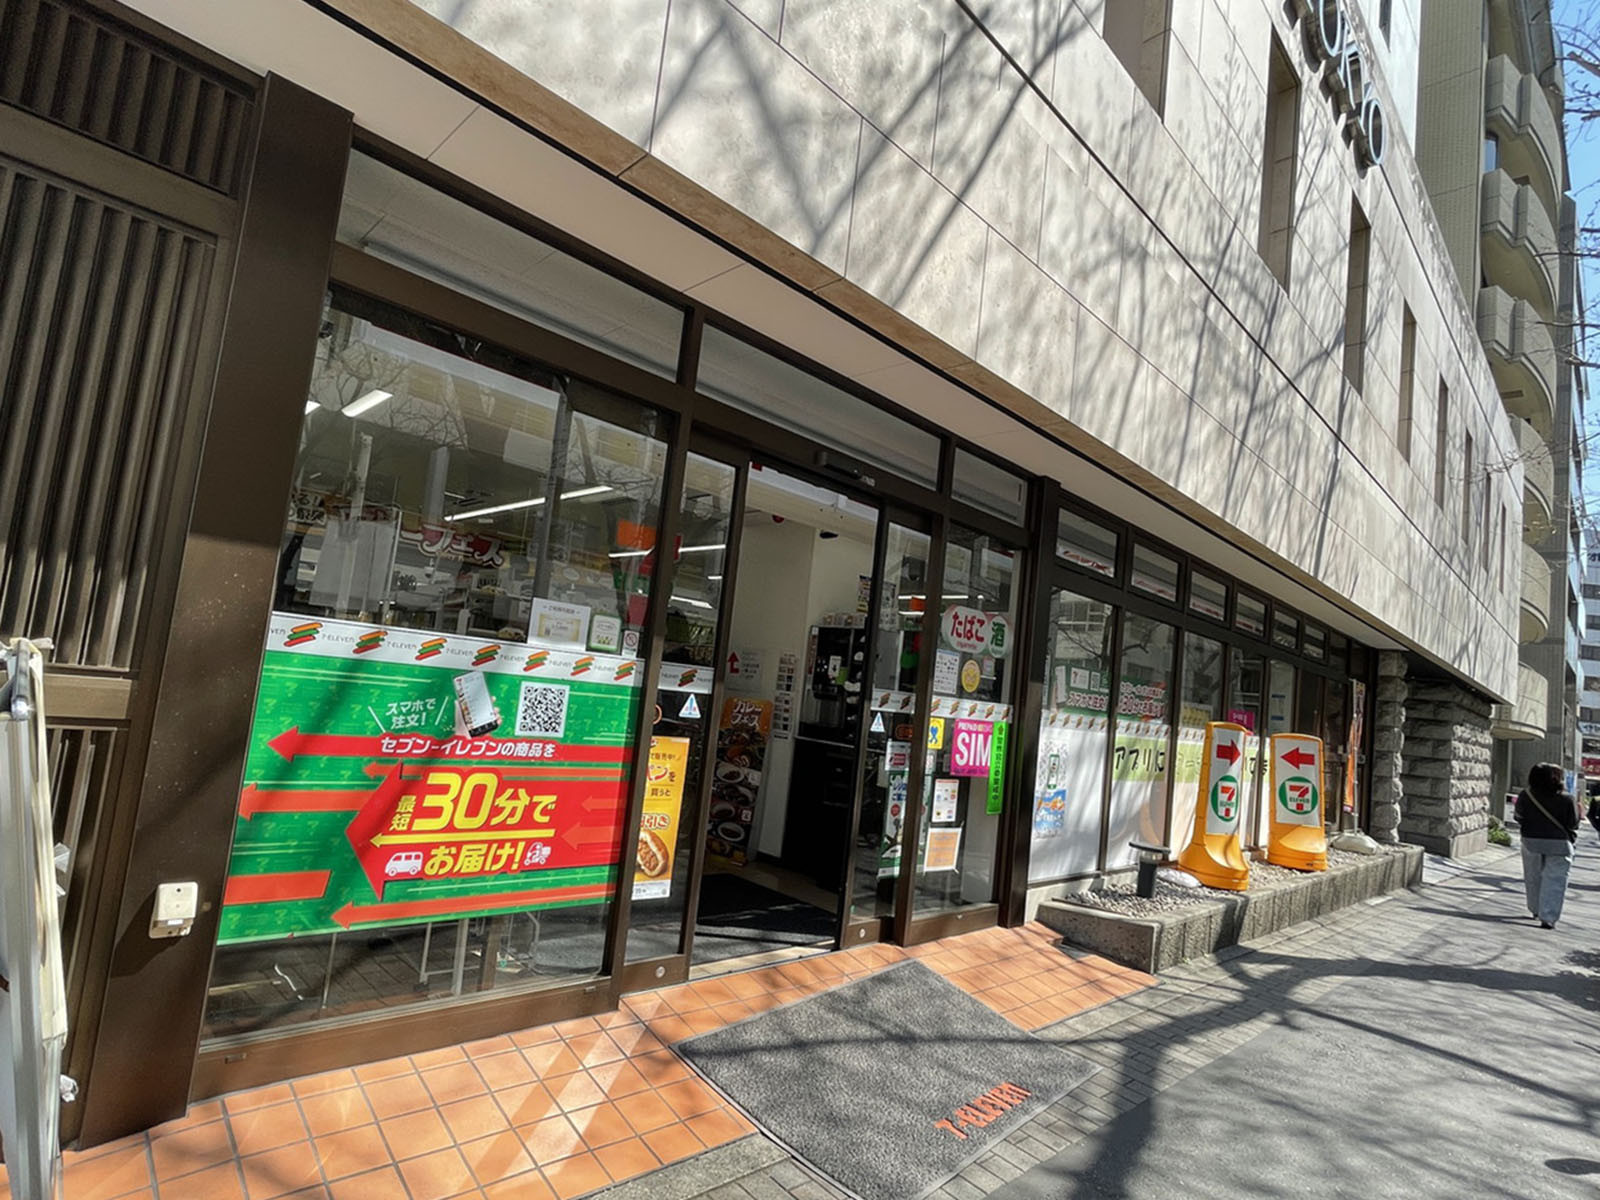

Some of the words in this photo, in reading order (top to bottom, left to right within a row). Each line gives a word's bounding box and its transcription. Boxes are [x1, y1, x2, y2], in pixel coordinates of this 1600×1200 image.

[951, 611, 985, 642] たばこ
[990, 621, 1006, 647] 酒
[386, 698, 436, 716] スマホで
[391, 713, 427, 730] 注文!
[955, 731, 993, 767] SIM
[389, 795, 417, 831] 最短
[411, 772, 558, 831] 30分で
[424, 841, 526, 876] お届け!
